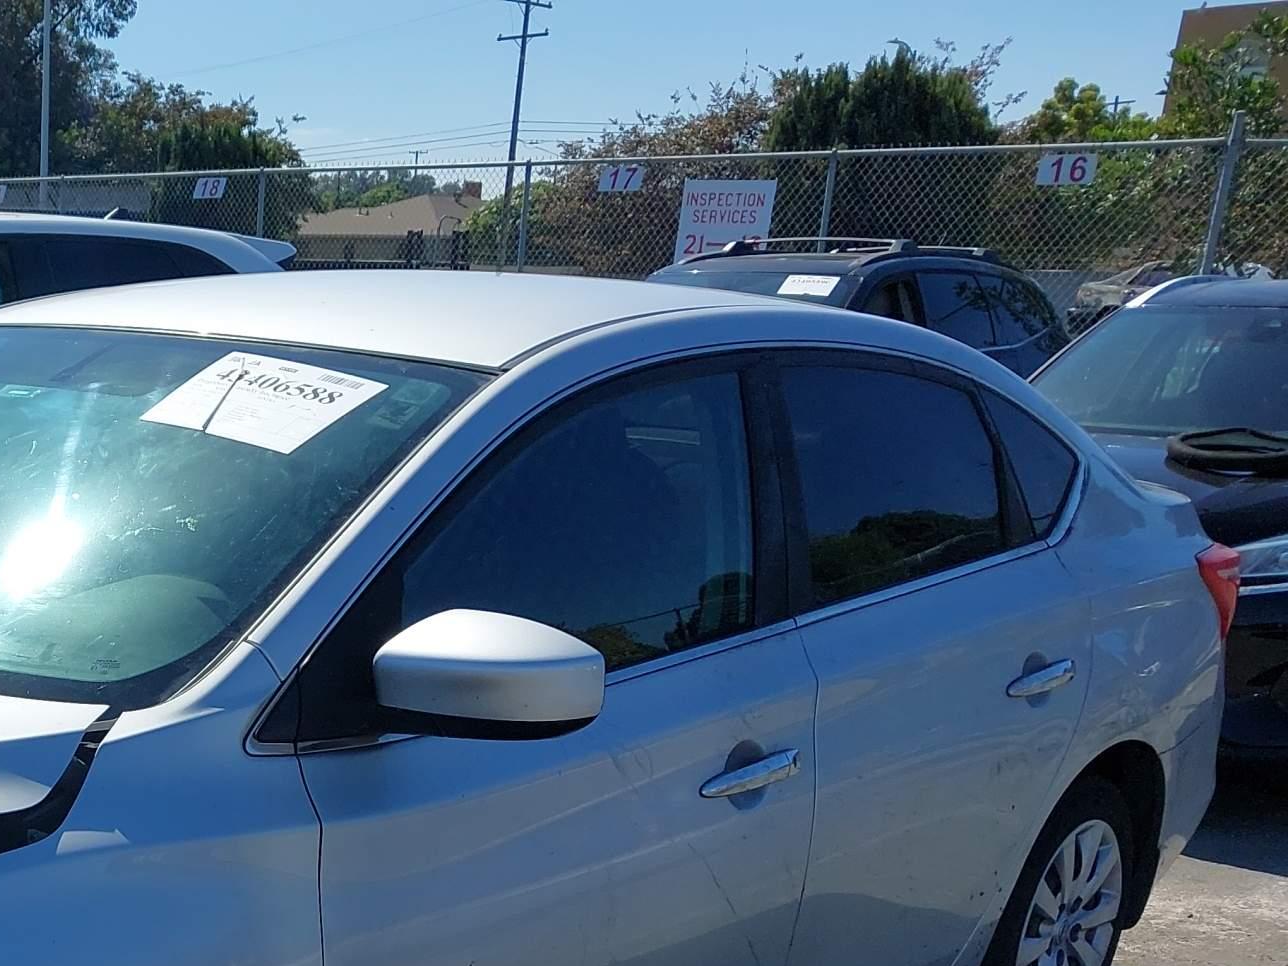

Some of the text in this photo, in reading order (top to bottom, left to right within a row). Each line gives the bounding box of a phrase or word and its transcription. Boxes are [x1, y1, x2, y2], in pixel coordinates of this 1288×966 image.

[608, 166, 639, 190] 17
[1051, 156, 1088, 183] 16
[200, 179, 220, 197] 18
[685, 191, 767, 207] INSPECTION
[691, 209, 758, 225] SERVICES
[683, 233, 706, 255] 21
